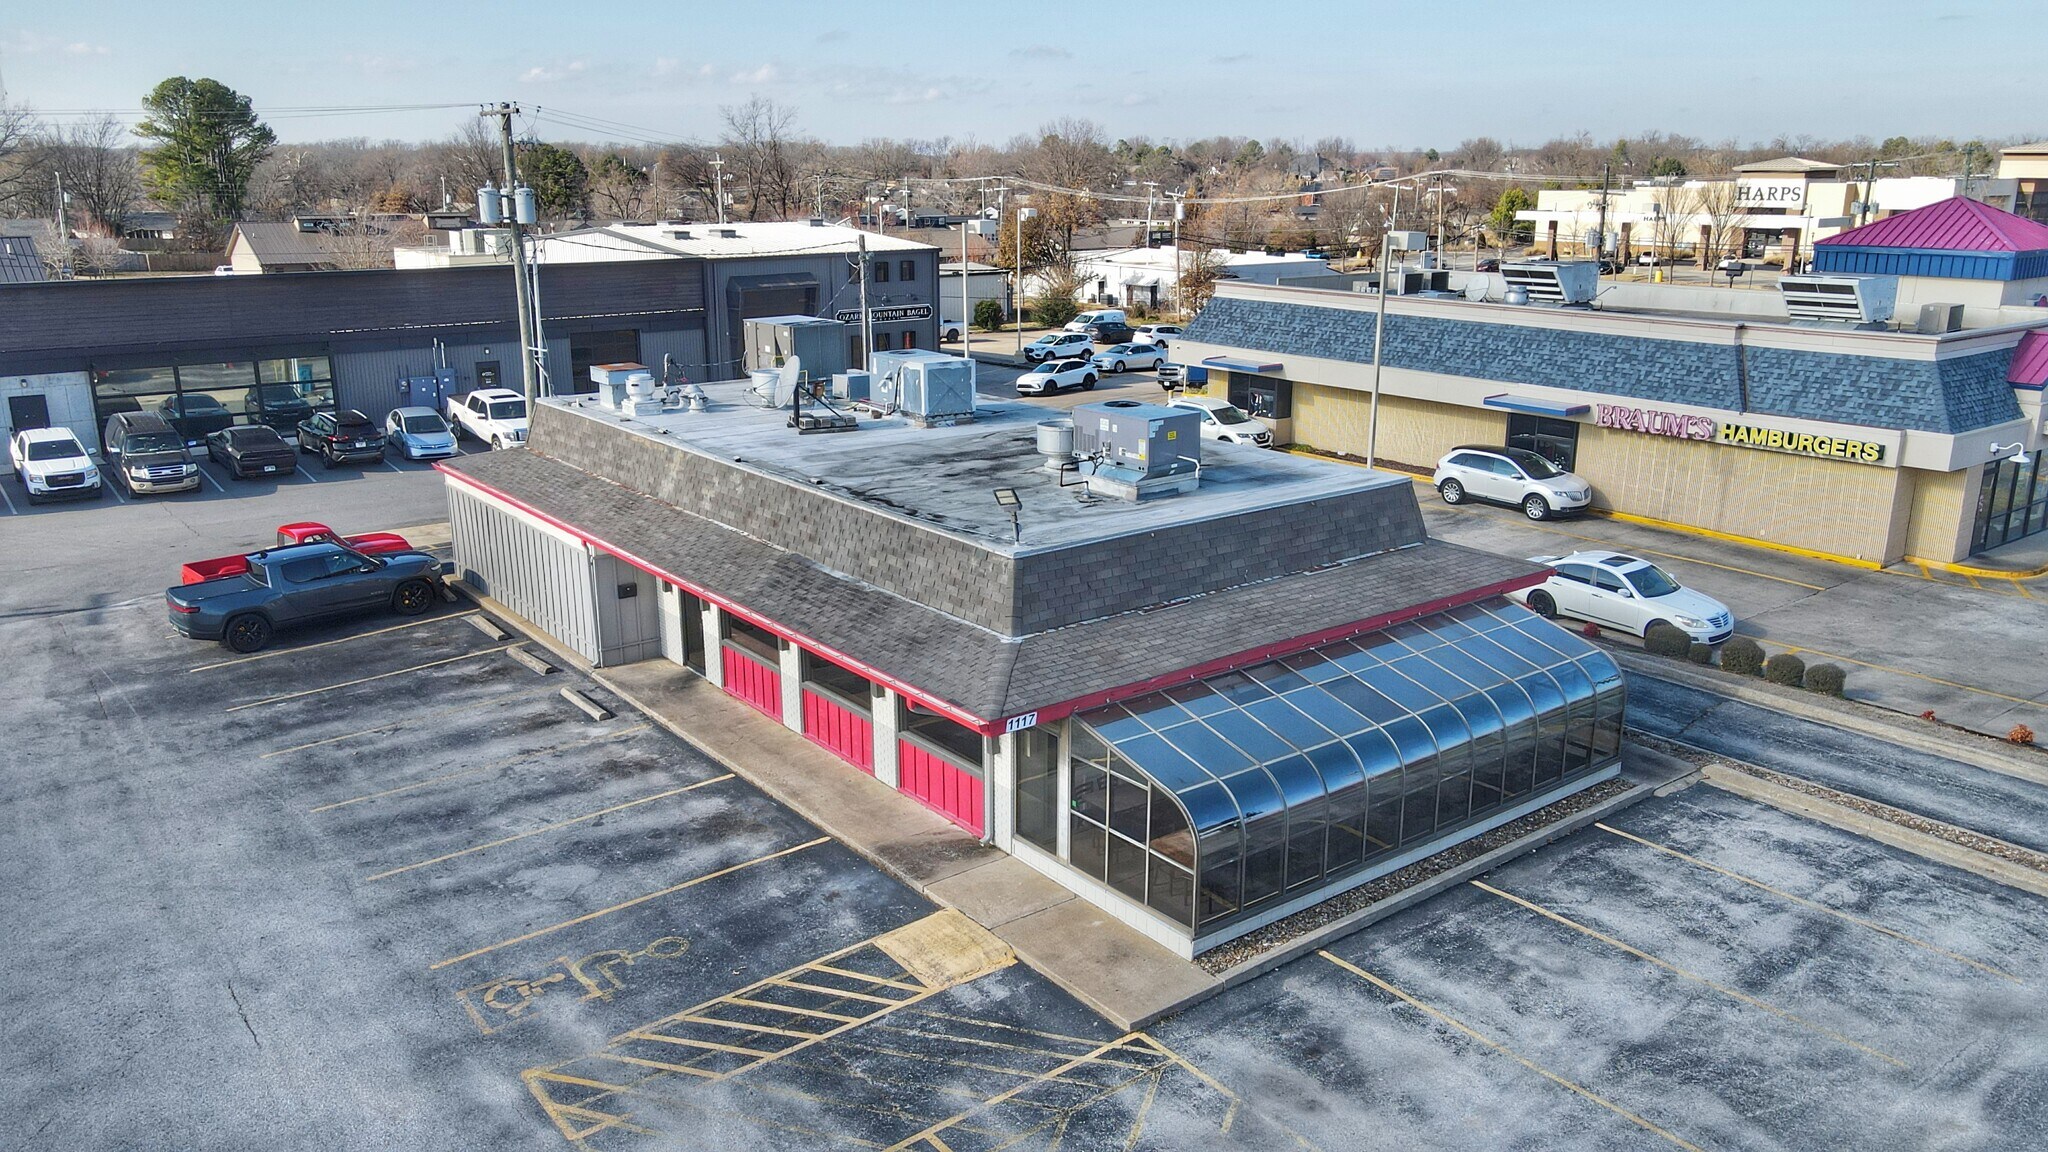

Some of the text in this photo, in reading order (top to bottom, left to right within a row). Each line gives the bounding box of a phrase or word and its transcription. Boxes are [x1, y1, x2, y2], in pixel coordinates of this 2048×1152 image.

[1736, 186, 1802, 202] HARPS
[870, 309, 905, 319] OUNTAIN
[906, 307, 929, 317] BAGEL
[1596, 403, 1880, 462] BRAUM'S HAMBURGERS
[1008, 713, 1036, 730] 1117
